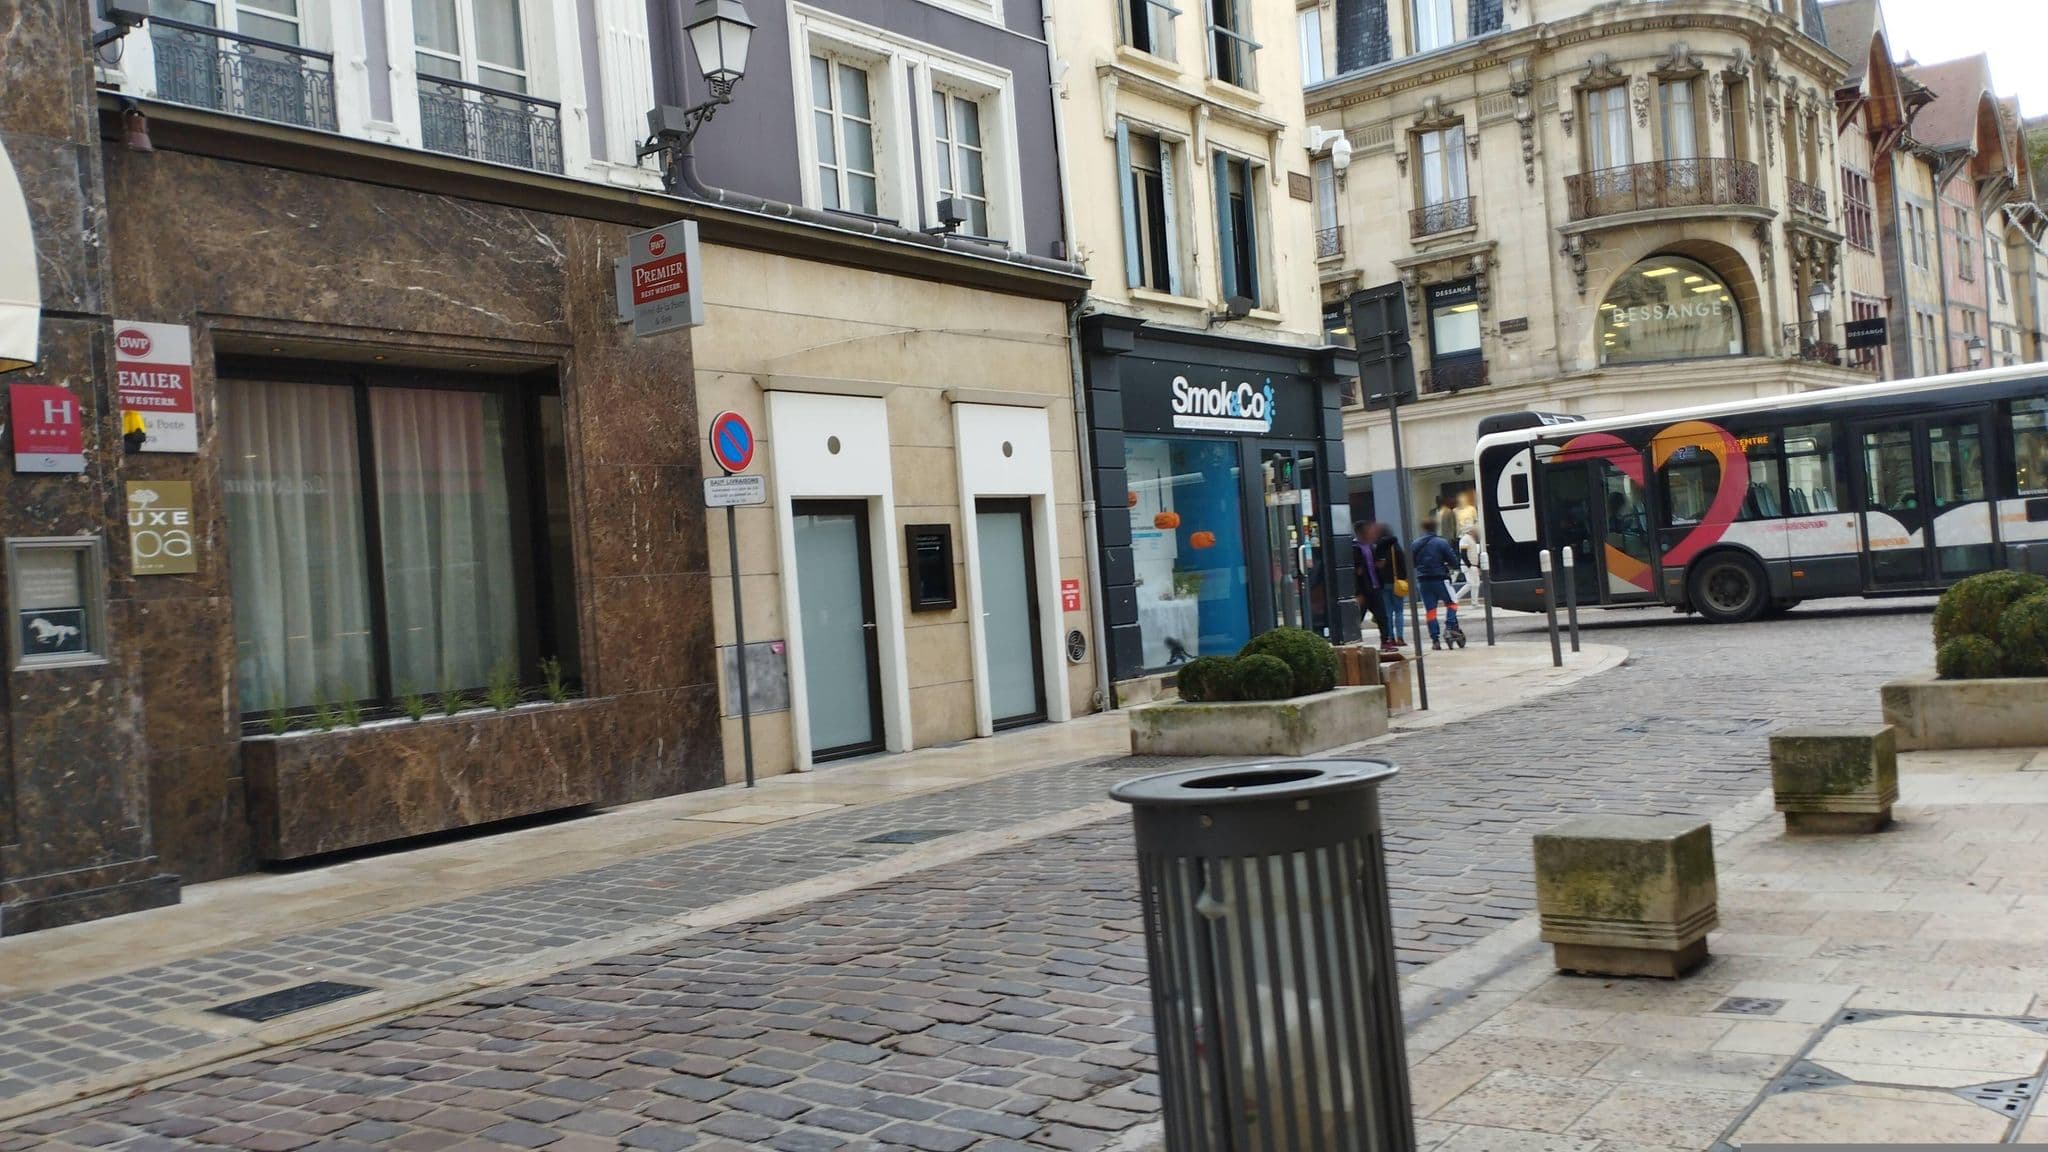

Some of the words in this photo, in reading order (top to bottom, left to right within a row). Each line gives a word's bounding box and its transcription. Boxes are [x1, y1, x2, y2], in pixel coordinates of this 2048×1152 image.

[636, 262, 684, 287] PREMIER
[641, 289, 655, 298] BEST
[655, 283, 681, 295] WESTERN
[1435, 285, 1471, 297] DESSANGE
[1612, 301, 1721, 322] DESSANGE
[1848, 327, 1884, 337] DESSANGE
[119, 337, 149, 349] BWP
[1172, 376, 1265, 418] Smok&Co
[42, 400, 73, 424] H
[1735, 435, 1769, 447] CENTRE
[128, 511, 189, 526] UXE
